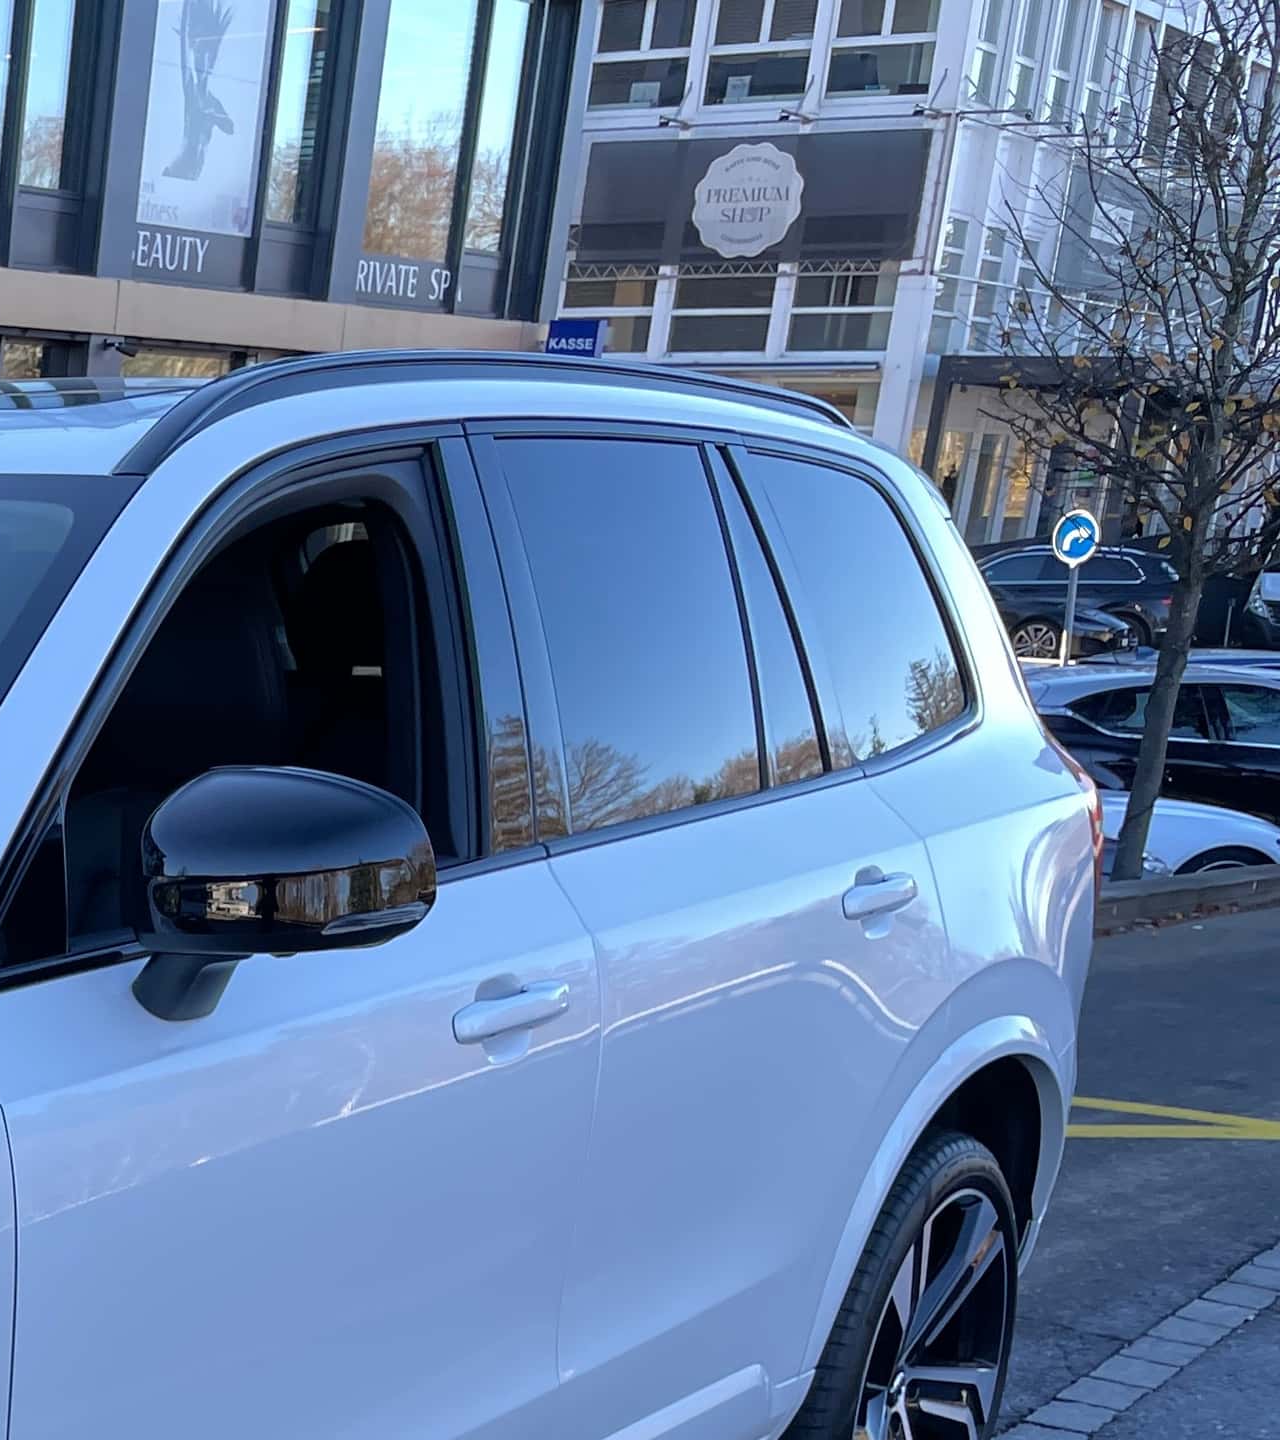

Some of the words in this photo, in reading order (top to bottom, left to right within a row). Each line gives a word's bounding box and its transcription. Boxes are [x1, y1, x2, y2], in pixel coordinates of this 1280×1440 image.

[706, 185, 789, 204] PREMIUM
[719, 207, 771, 223] SHOP
[132, 230, 209, 272] EAUTY
[355, 259, 419, 298] RIVATE
[427, 268, 462, 302] SP
[548, 337, 594, 351] KASSE
